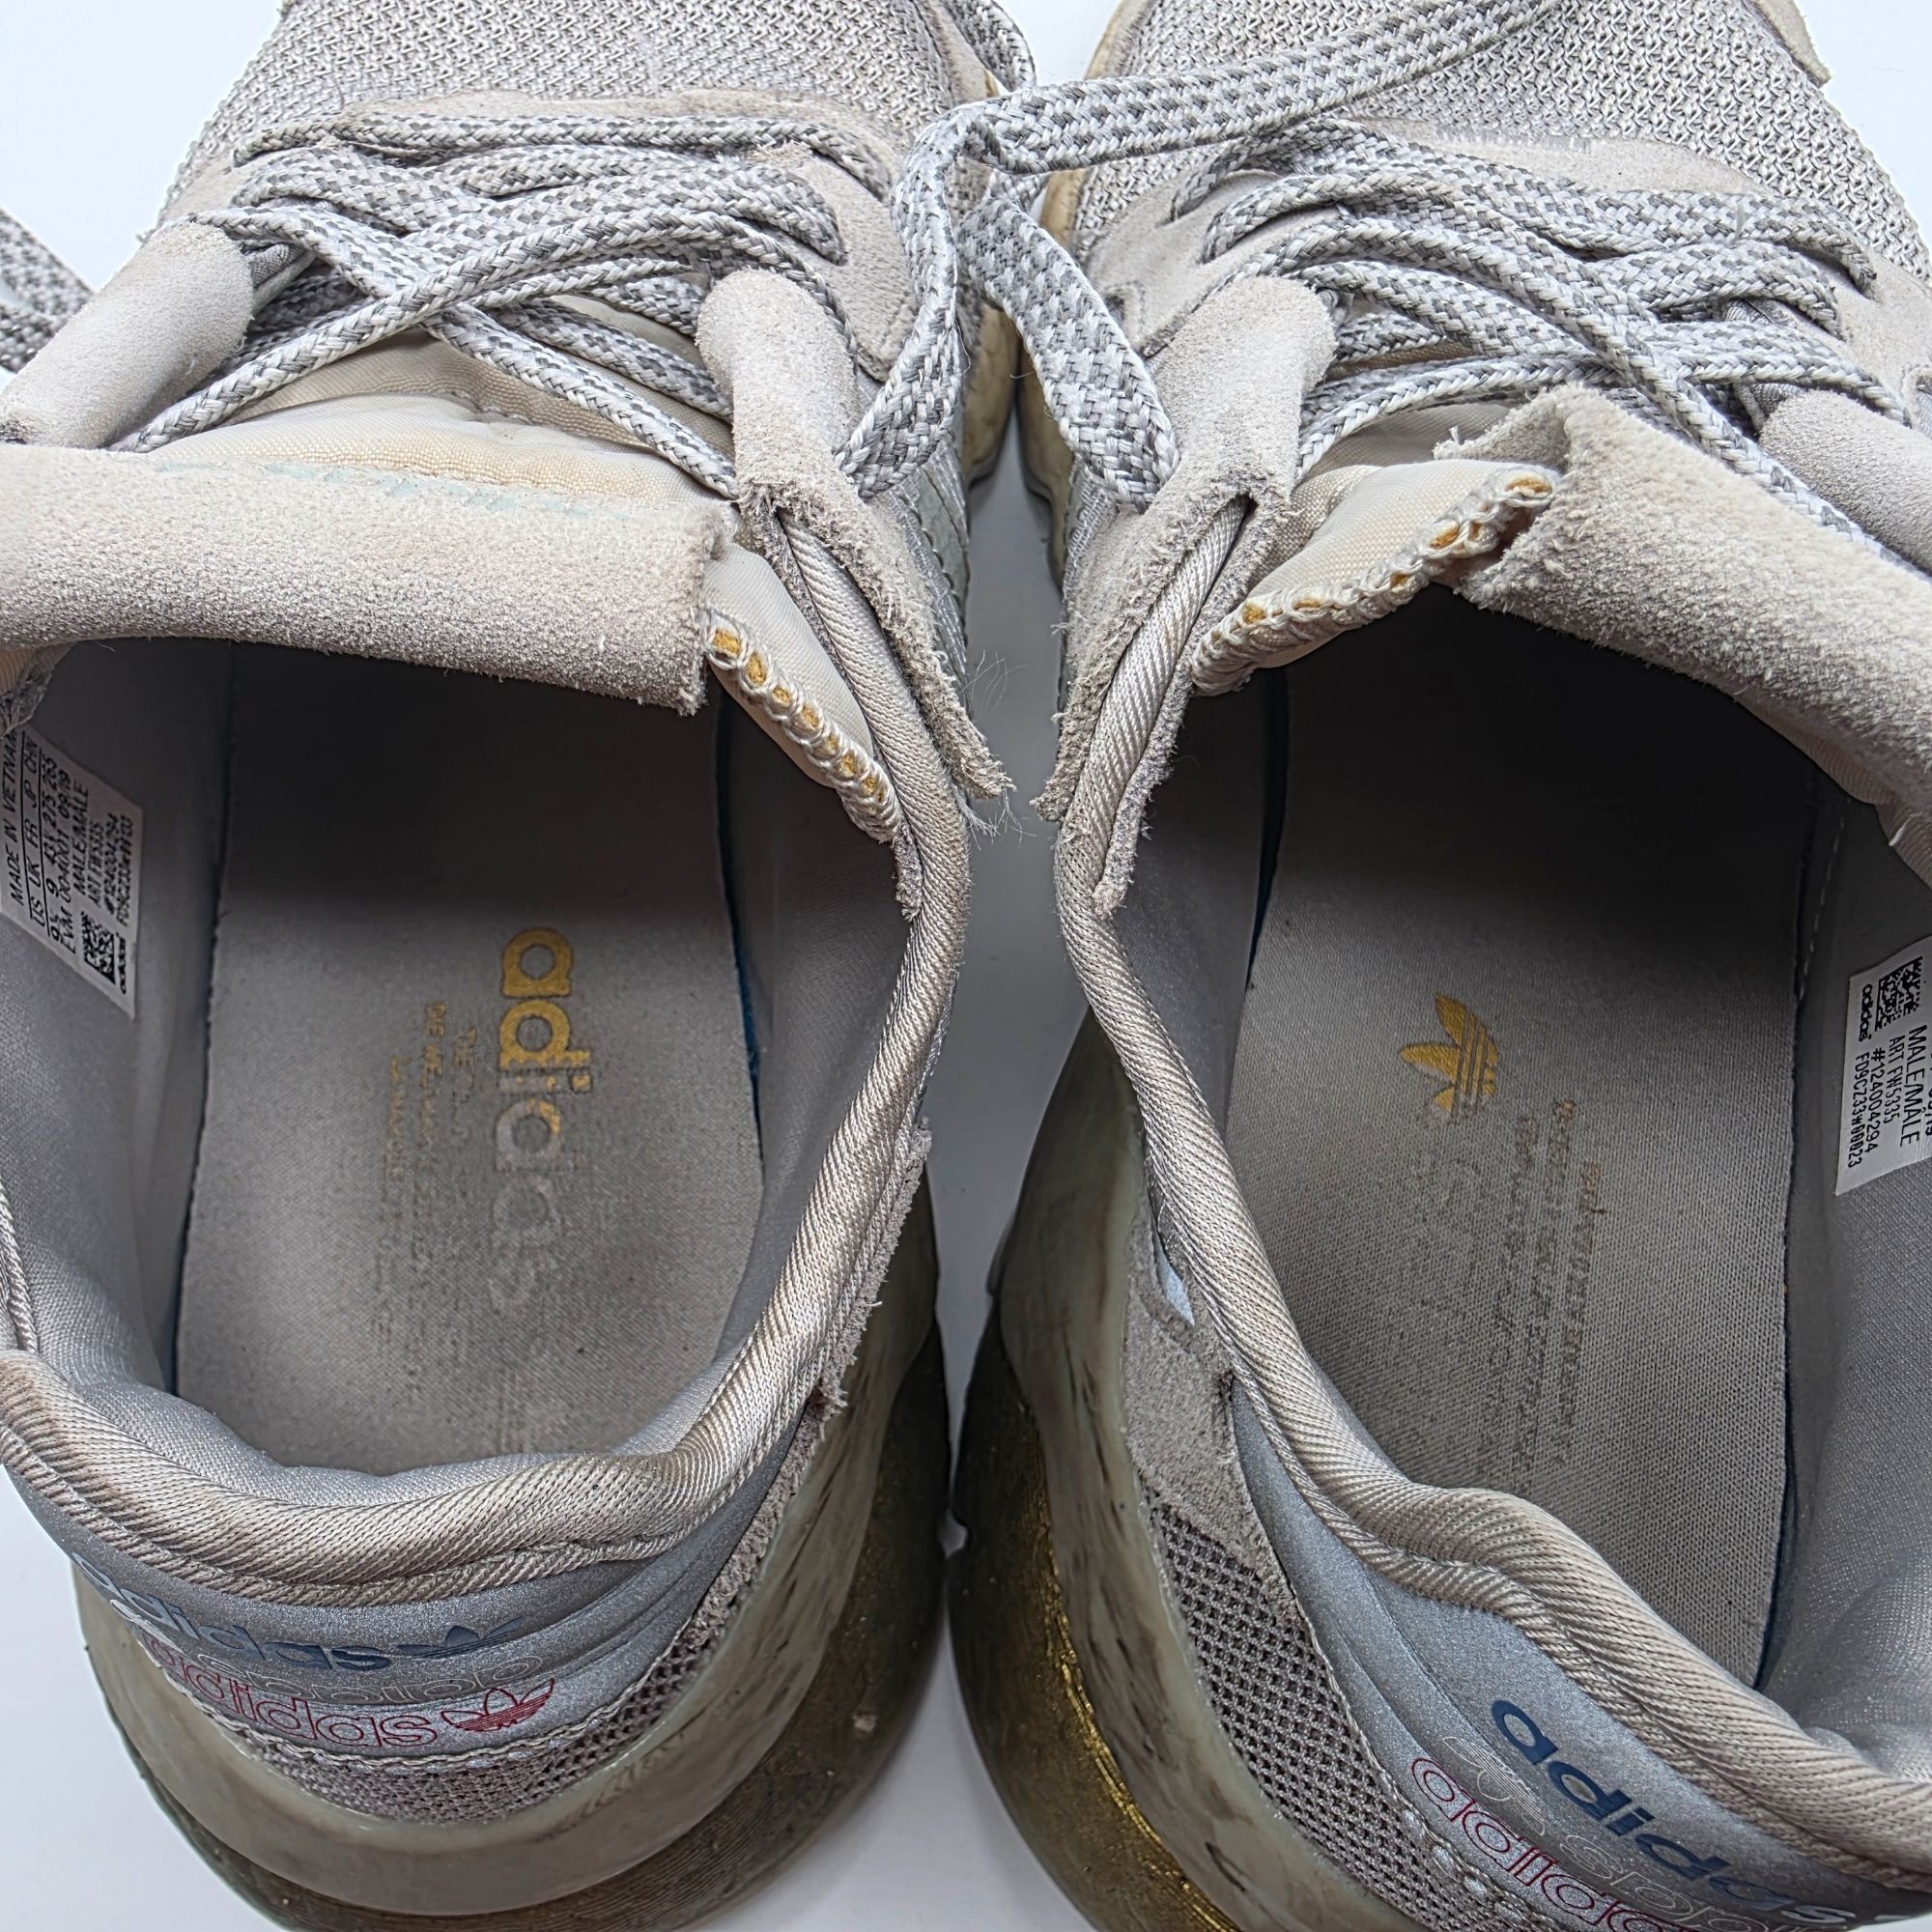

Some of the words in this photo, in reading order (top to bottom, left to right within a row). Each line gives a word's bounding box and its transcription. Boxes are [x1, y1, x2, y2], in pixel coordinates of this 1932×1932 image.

[24, 780, 37, 809] JP
[4, 819, 19, 843] IN
[24, 819, 38, 848] FR
[6, 844, 24, 906] MADE
[27, 856, 42, 888] UK
[31, 896, 45, 927] US
[1859, 983, 1873, 1042] adidas
[1889, 1035, 1906, 1064] ART
[1864, 1047, 1887, 1153] #124004294
[1883, 1066, 1903, 1124] FW5335
[1900, 1025, 1927, 1148] MALE/MÂLE
[72, 1552, 391, 1670] adidas
[142, 1633, 438, 1747] adidas
[1491, 1699, 1857, 1922] adidas
